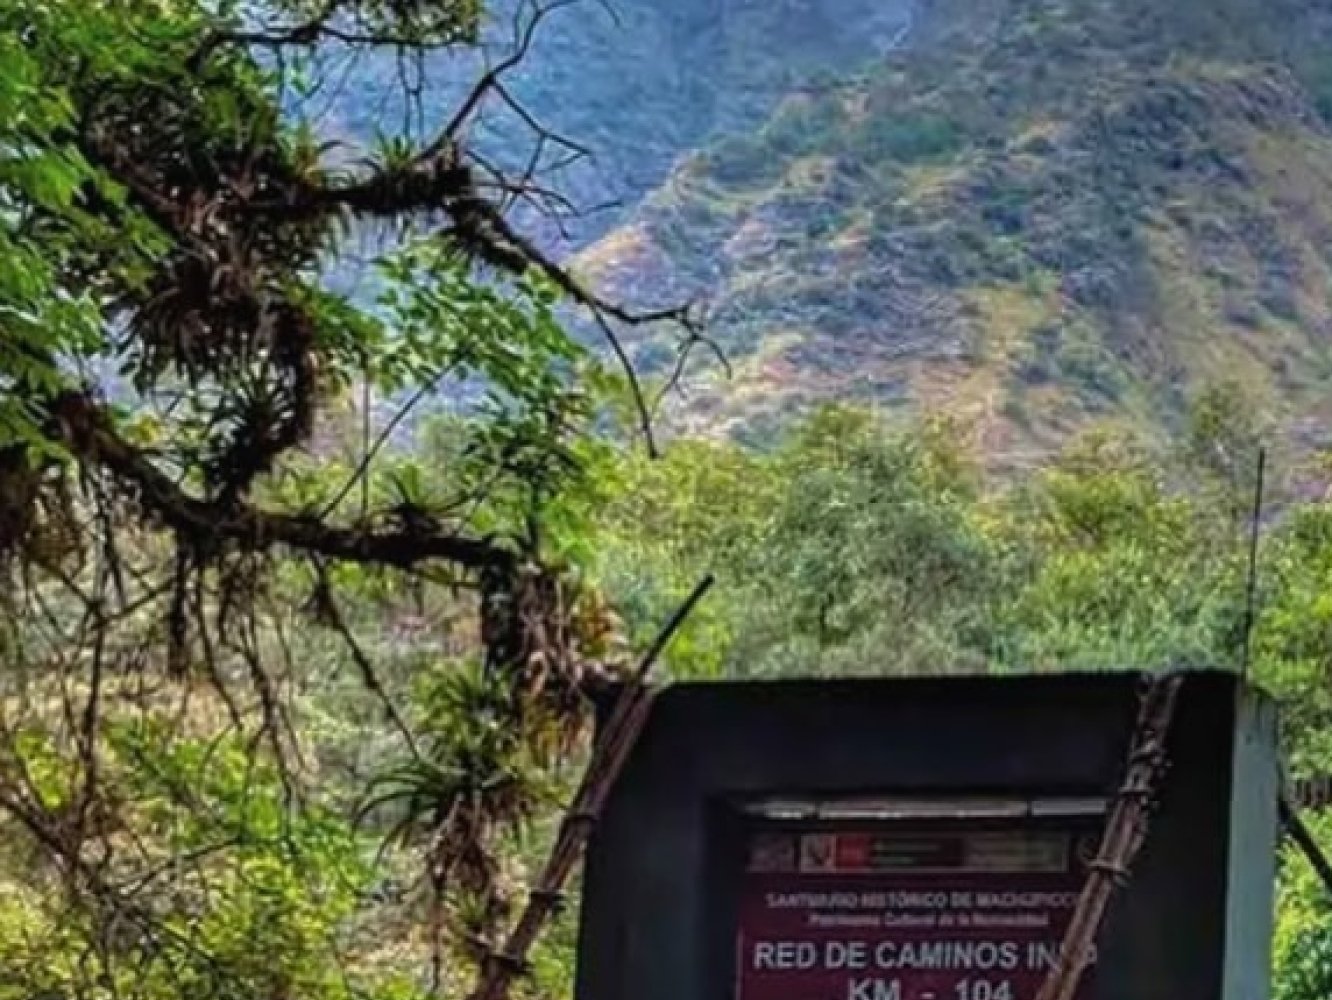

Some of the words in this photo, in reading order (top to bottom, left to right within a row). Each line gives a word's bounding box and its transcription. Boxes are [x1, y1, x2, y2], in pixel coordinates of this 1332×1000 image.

[951, 893, 972, 908] DE
[754, 943, 816, 969] RED
[825, 943, 868, 969] DE
[875, 943, 1019, 969] CAMINOS
